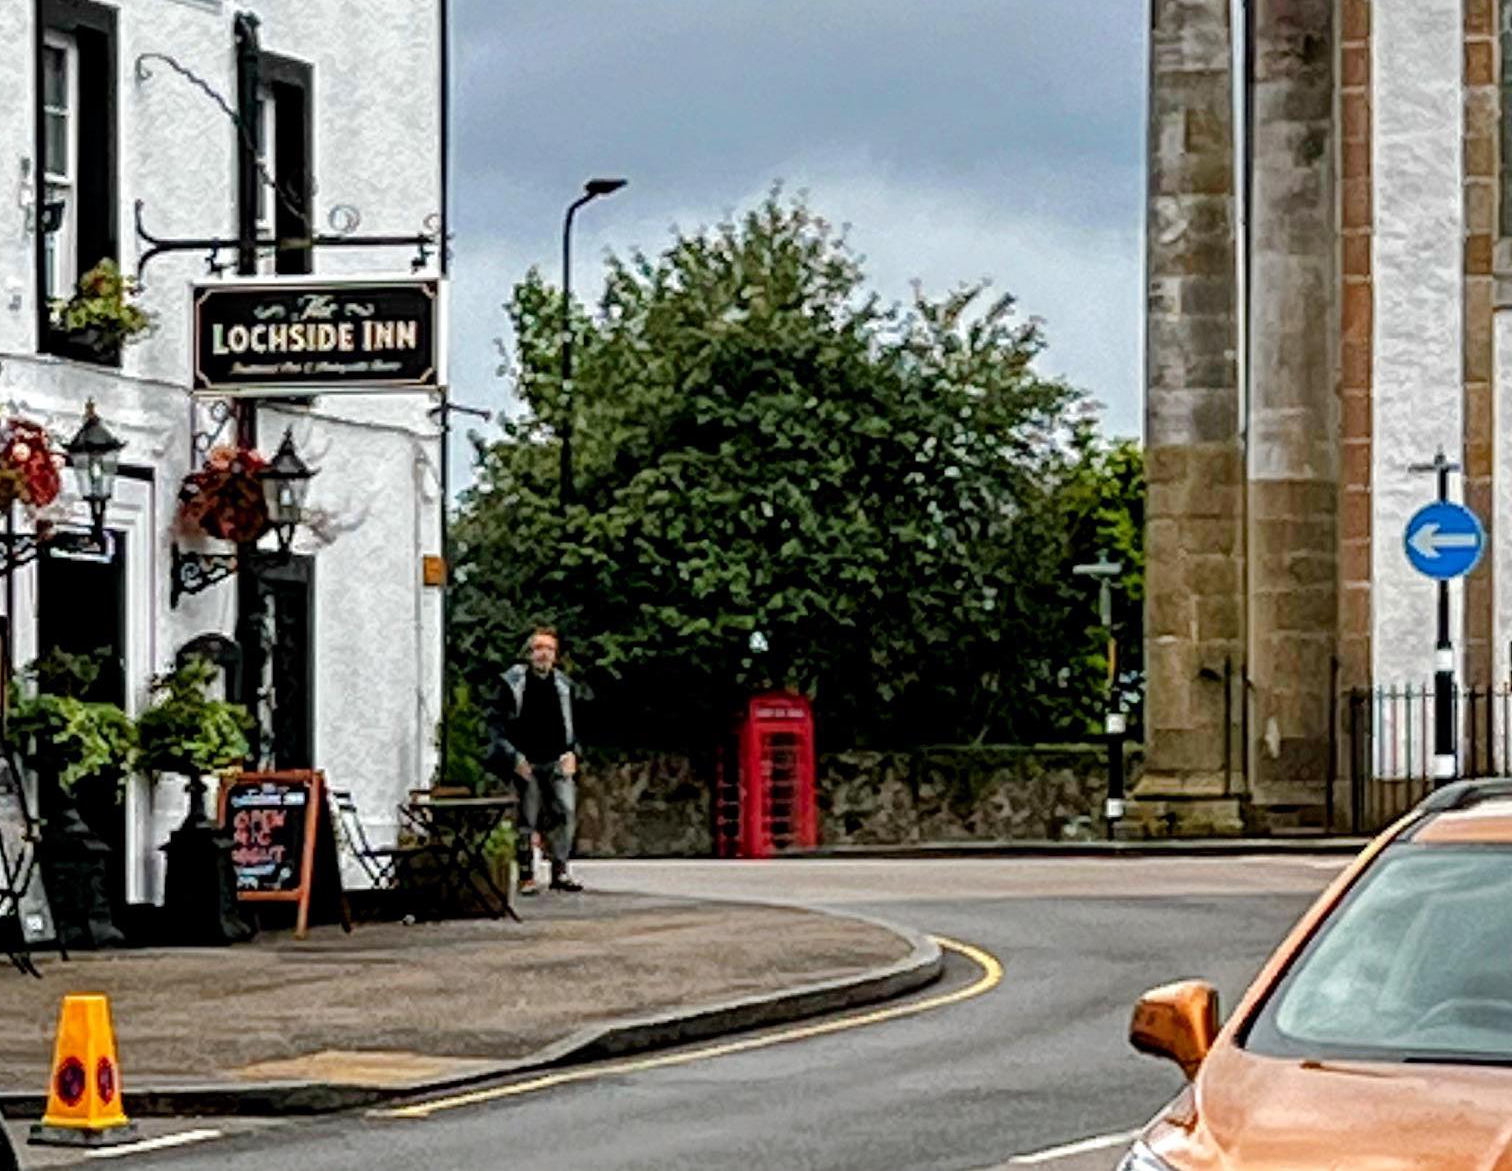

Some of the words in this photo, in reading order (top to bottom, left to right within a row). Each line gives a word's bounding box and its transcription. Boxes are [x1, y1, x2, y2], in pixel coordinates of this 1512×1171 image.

[290, 294, 338, 321] The
[212, 322, 354, 355] LOCHSIDE
[362, 321, 417, 352] INN
